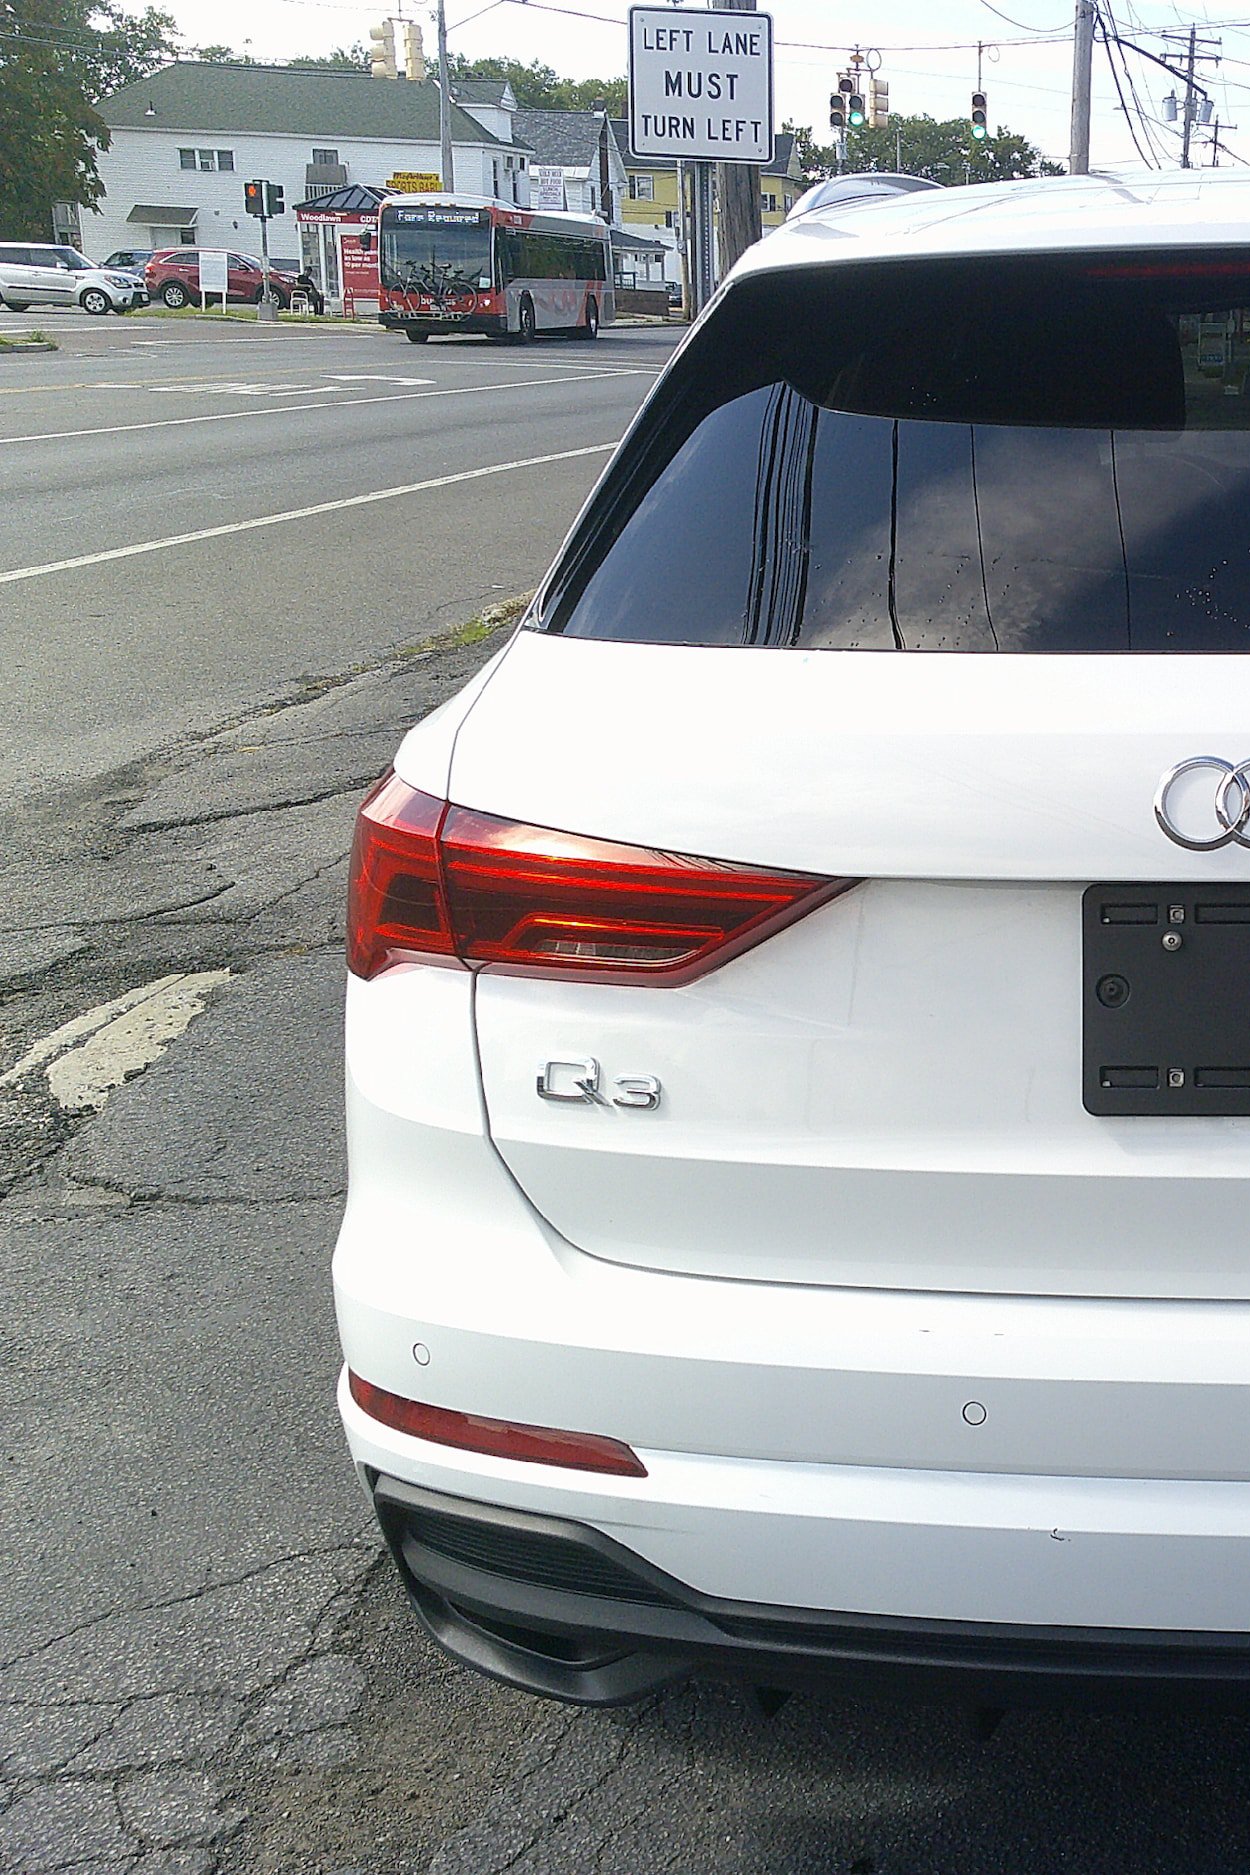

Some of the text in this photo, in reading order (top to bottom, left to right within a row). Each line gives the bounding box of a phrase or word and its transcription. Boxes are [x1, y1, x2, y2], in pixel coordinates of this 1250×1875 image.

[643, 28, 761, 56] LEFT LANE
[664, 70, 739, 100] MUST
[641, 115, 762, 143] TURN LEFT
[300, 213, 342, 223] Woodlawn
[397, 210, 480, 223] Fare Required
[536, 1056, 662, 1111] Q3
